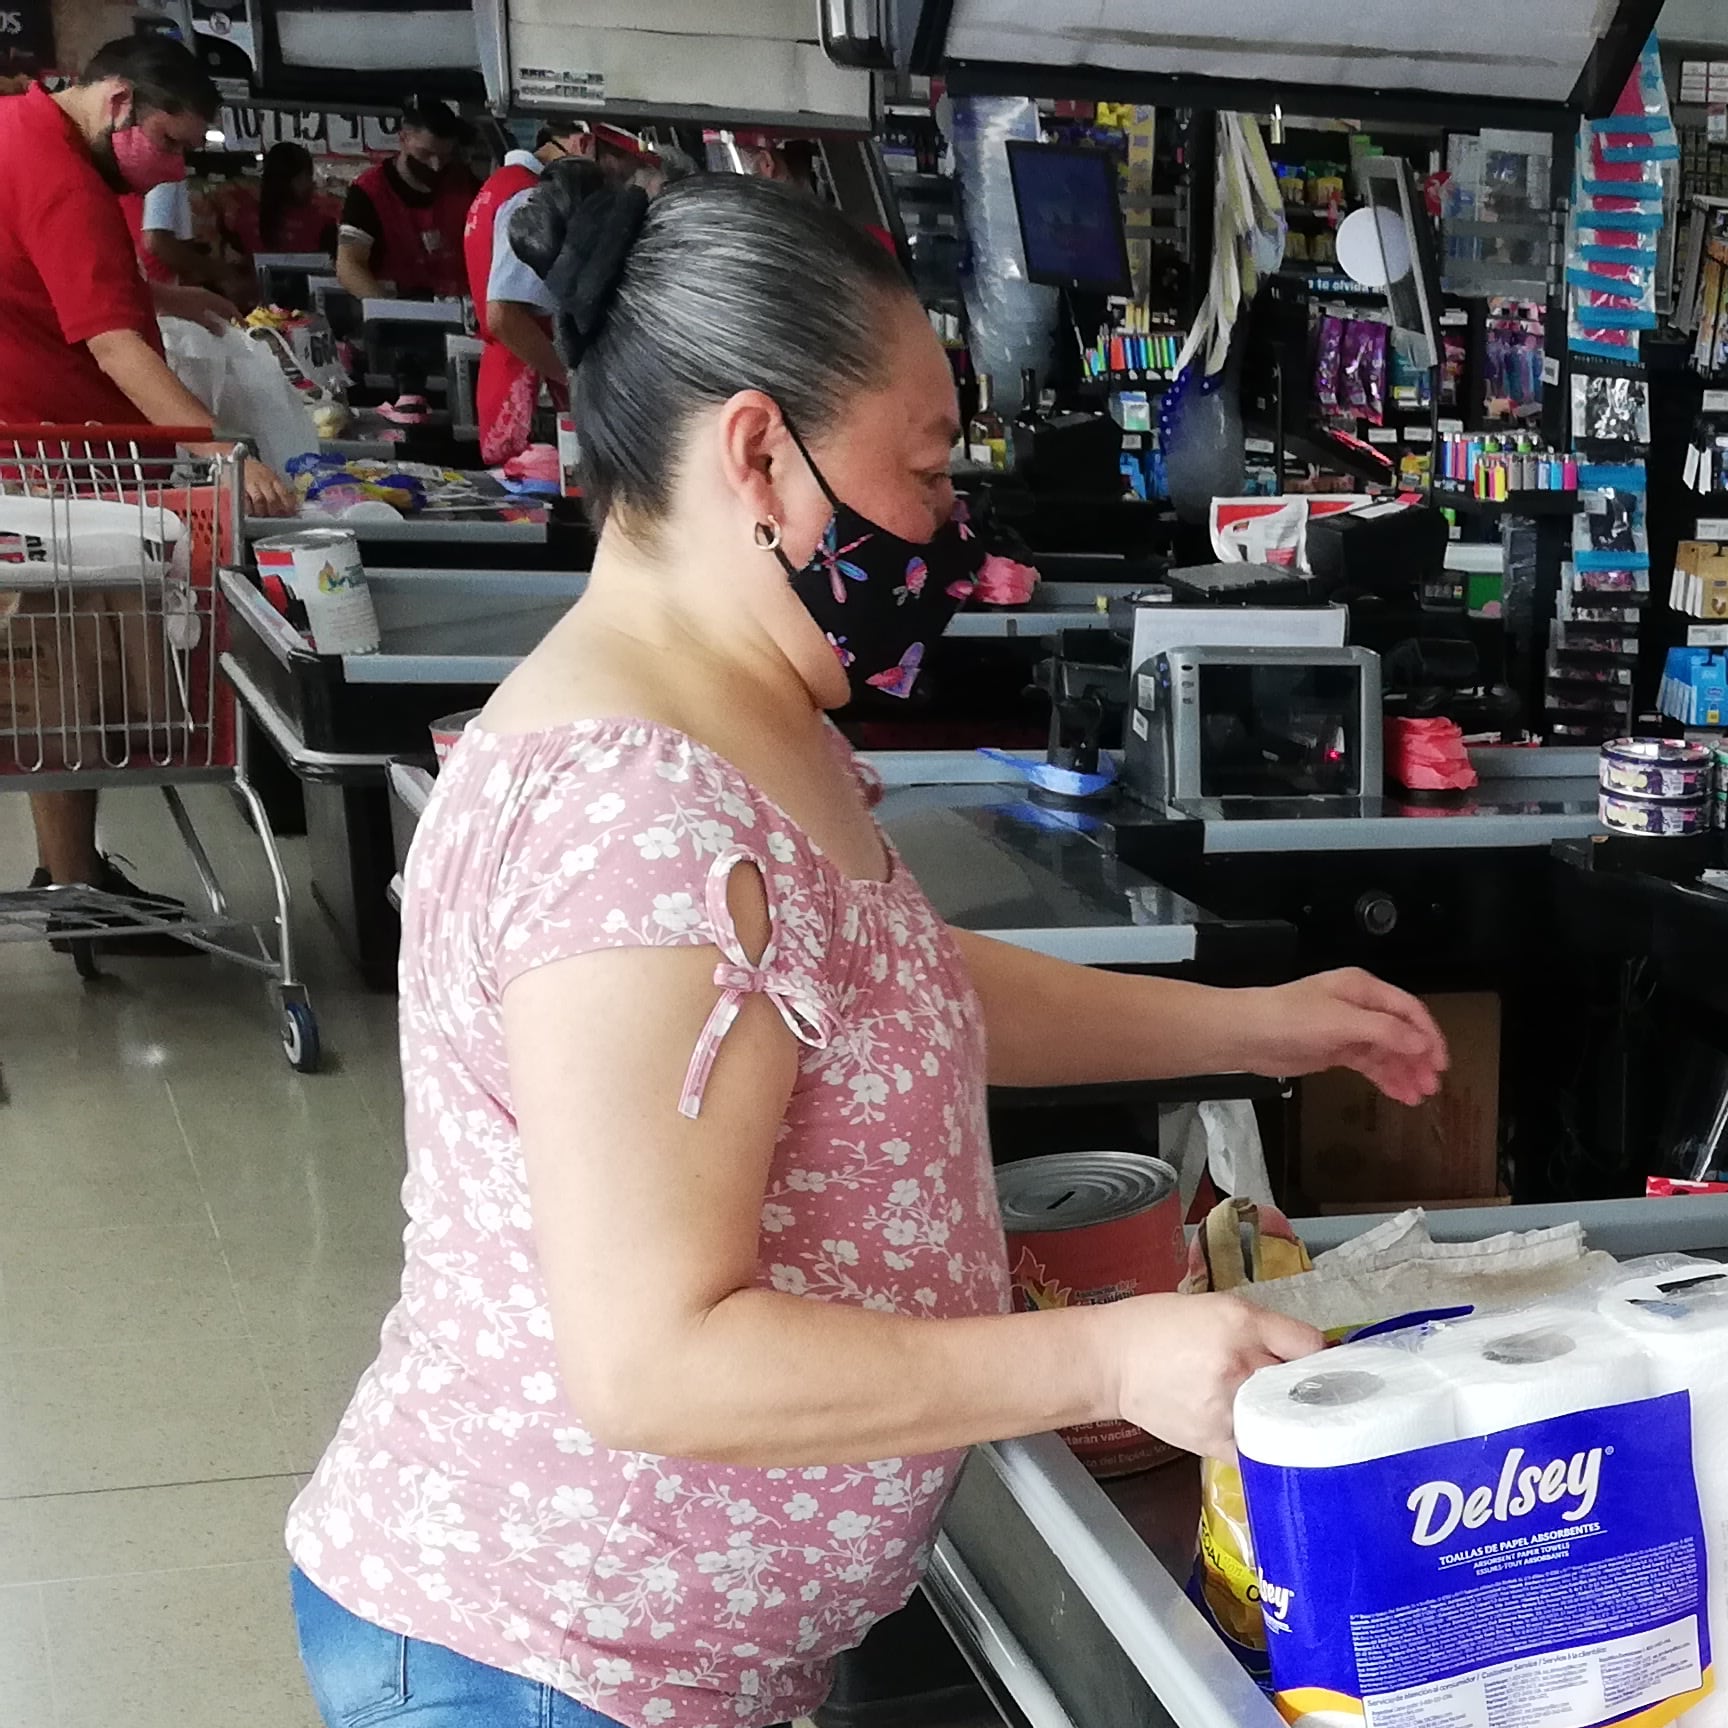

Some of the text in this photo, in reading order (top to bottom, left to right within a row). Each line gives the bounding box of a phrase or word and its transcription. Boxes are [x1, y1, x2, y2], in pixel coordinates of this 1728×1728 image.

[1406, 1448, 1602, 1546] Delsey
[1439, 1522, 1601, 1566] TOALLAS DE PAPEL ABSORBENTES
[1473, 1542, 1570, 1569] ABSORBENT PAPER TOWELS
[1524, 1550, 1570, 1566] ABSORBANTS
